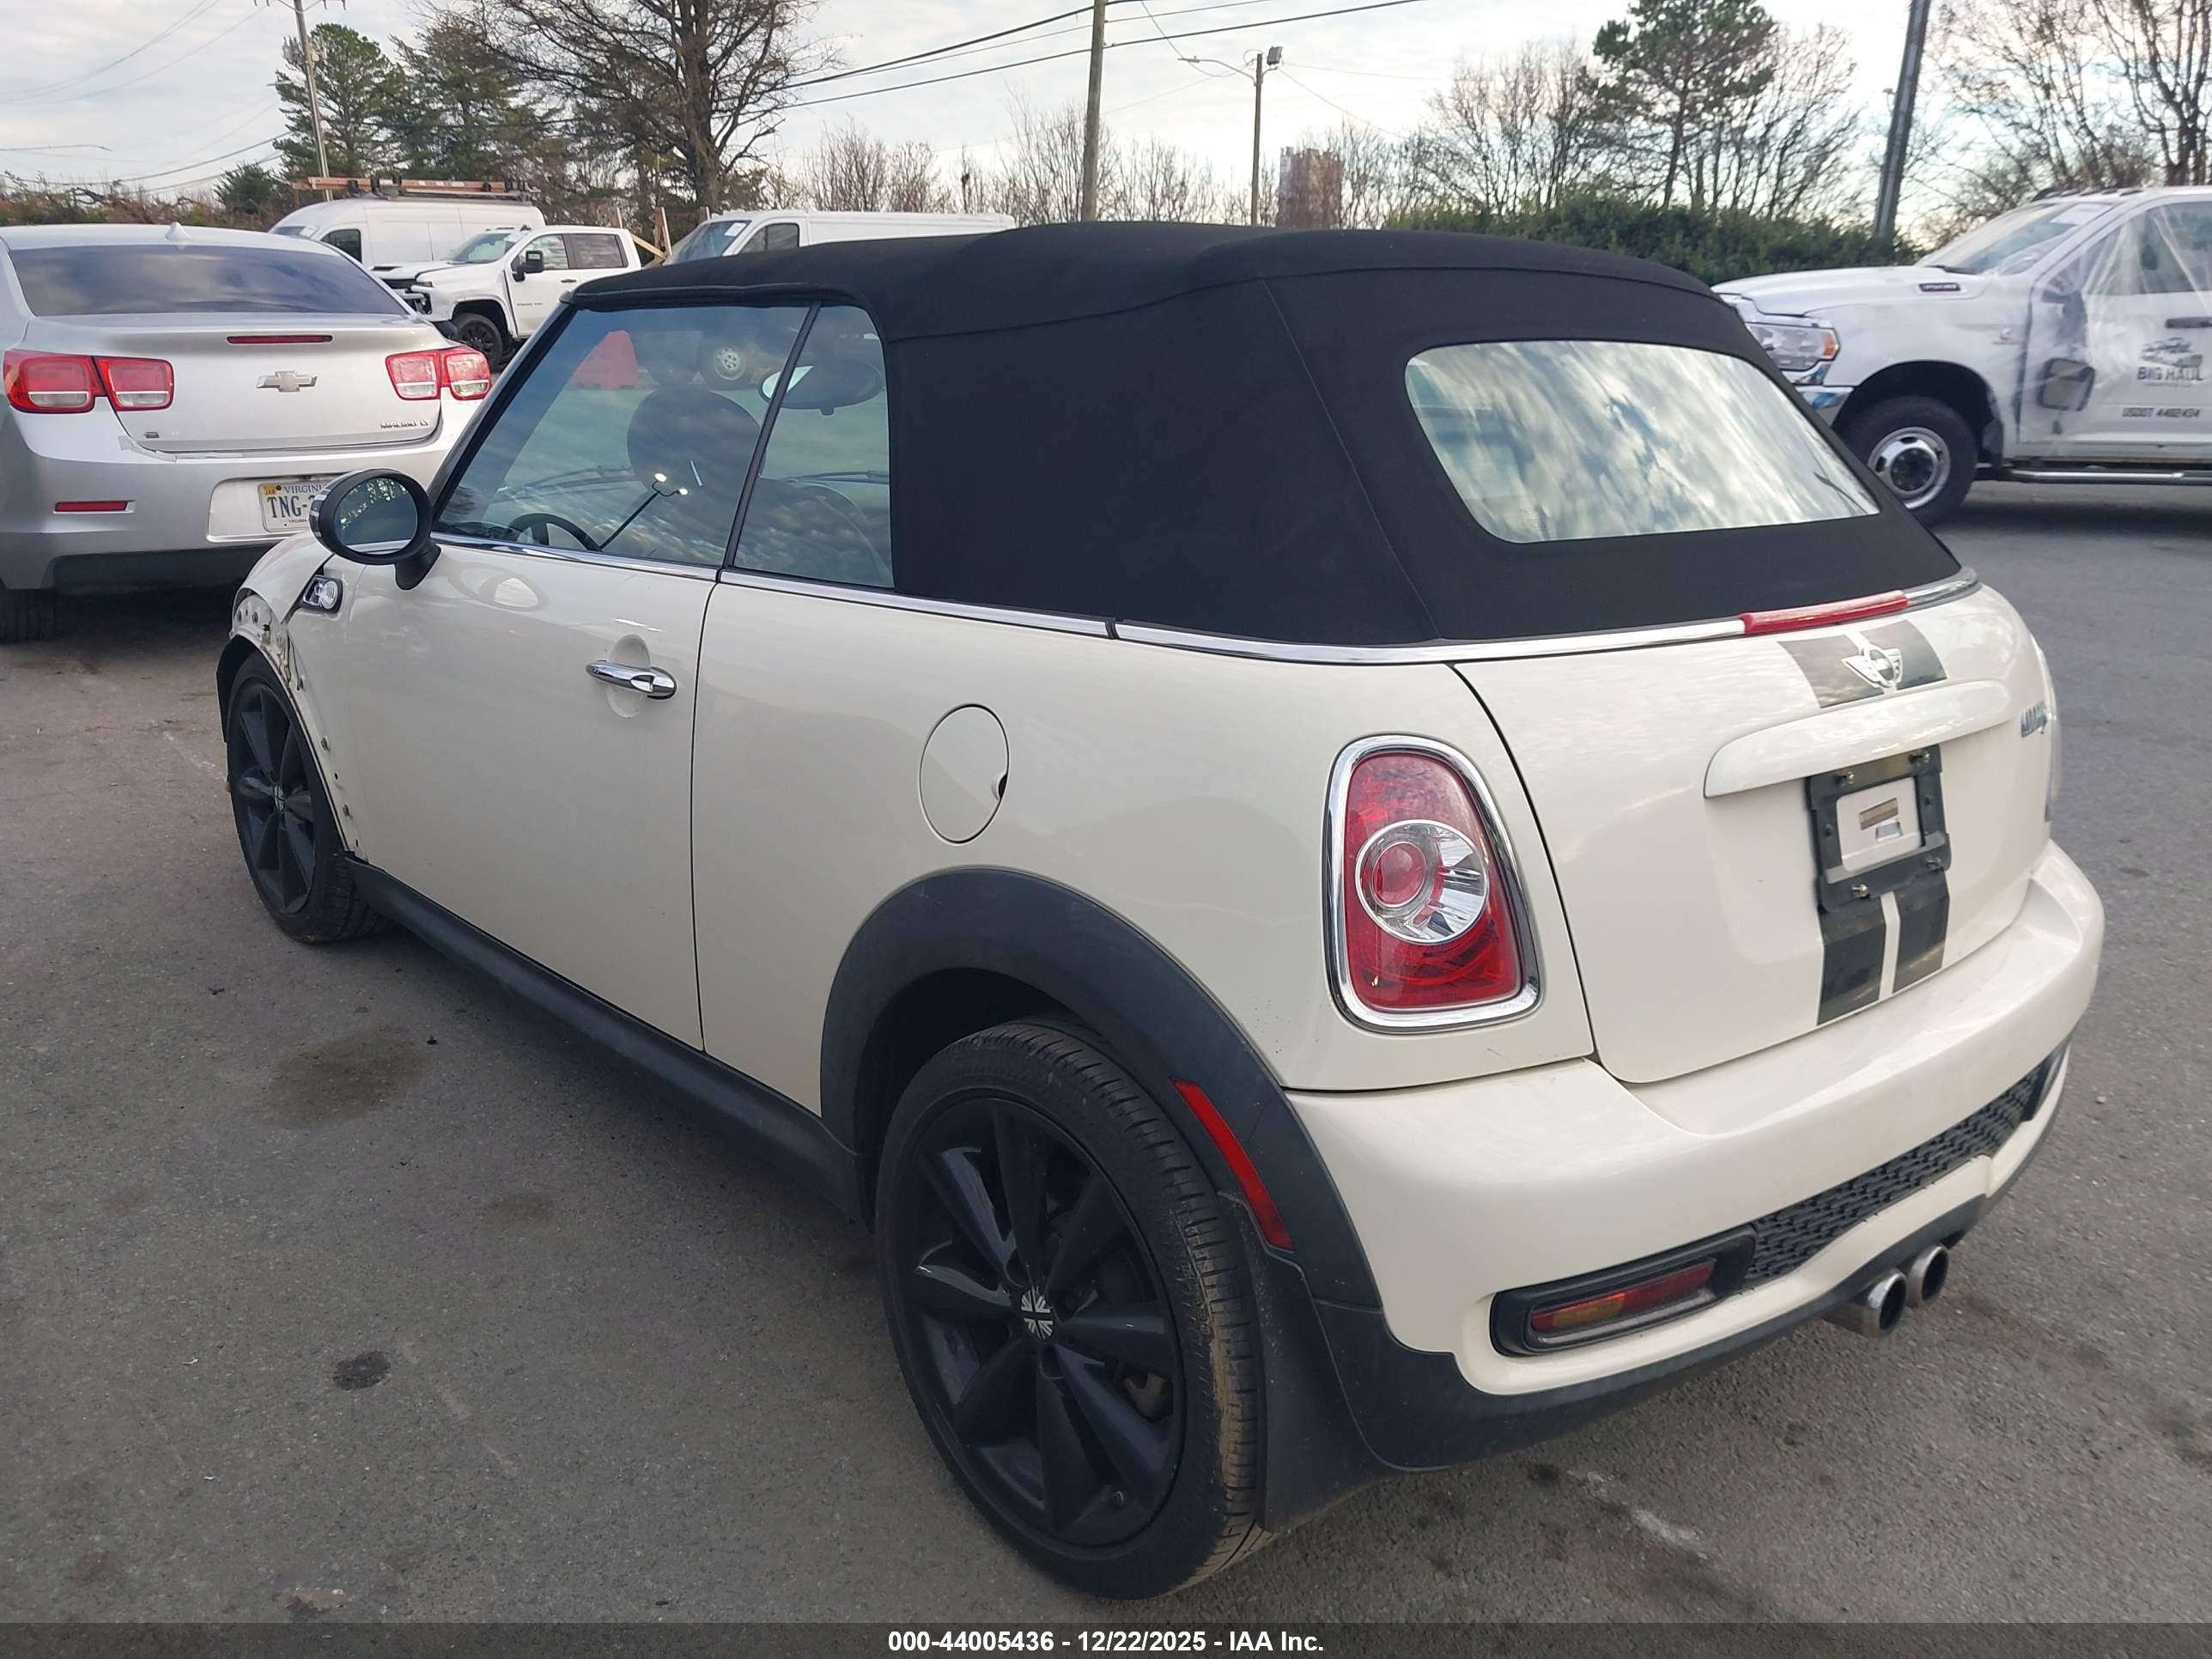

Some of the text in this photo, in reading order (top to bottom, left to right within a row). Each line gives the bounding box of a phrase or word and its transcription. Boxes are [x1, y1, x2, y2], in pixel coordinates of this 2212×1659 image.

[2136, 366, 2203, 382] BIG HAUL
[283, 484, 323, 494] VIRGINI
